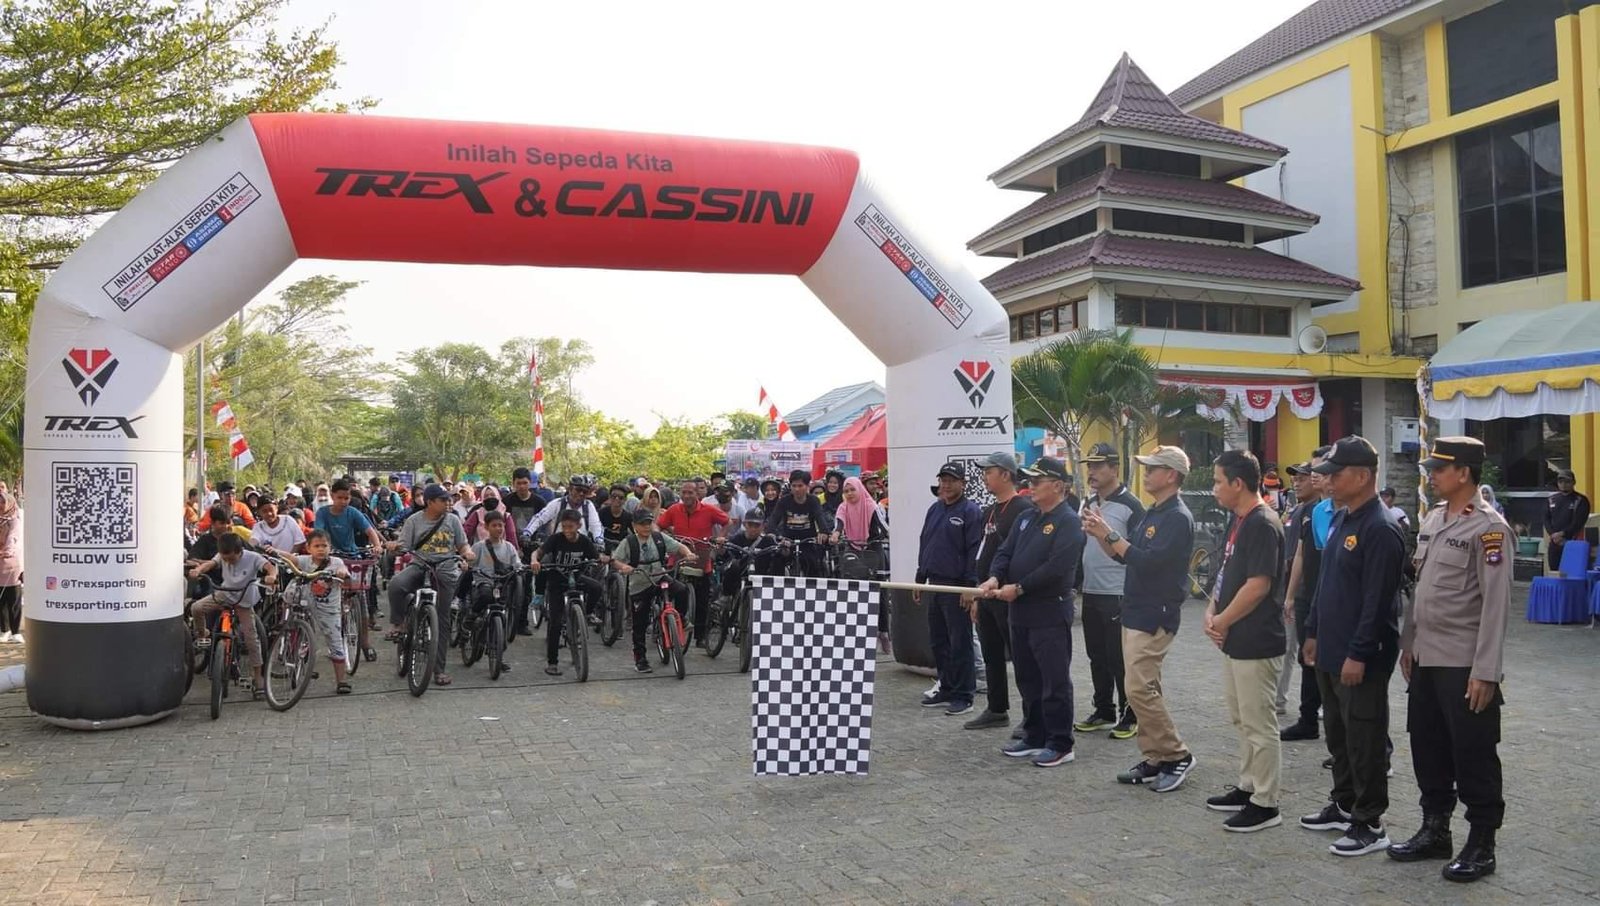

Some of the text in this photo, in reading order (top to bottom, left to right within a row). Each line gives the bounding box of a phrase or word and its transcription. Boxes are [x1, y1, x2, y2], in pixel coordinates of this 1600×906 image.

[447, 143, 673, 172] Inilah Sepeda Kita
[315, 167, 814, 226] TREX & CASSINI
[114, 183, 239, 288] INILAH ALAT-ALAT SEPEDA KITA
[872, 212, 895, 237] INILAH
[892, 234, 926, 269] ALAT-ALAT
[924, 267, 950, 295] SEPEDA
[948, 292, 964, 311] KITA
[45, 416, 146, 438] TREX
[937, 414, 1009, 435] TREX
[1446, 537, 1469, 550] POLRI
[52, 553, 138, 564] FOLLOW US!
[60, 578, 146, 590] @Trexsporting
[45, 599, 148, 612] trexsporting.com
